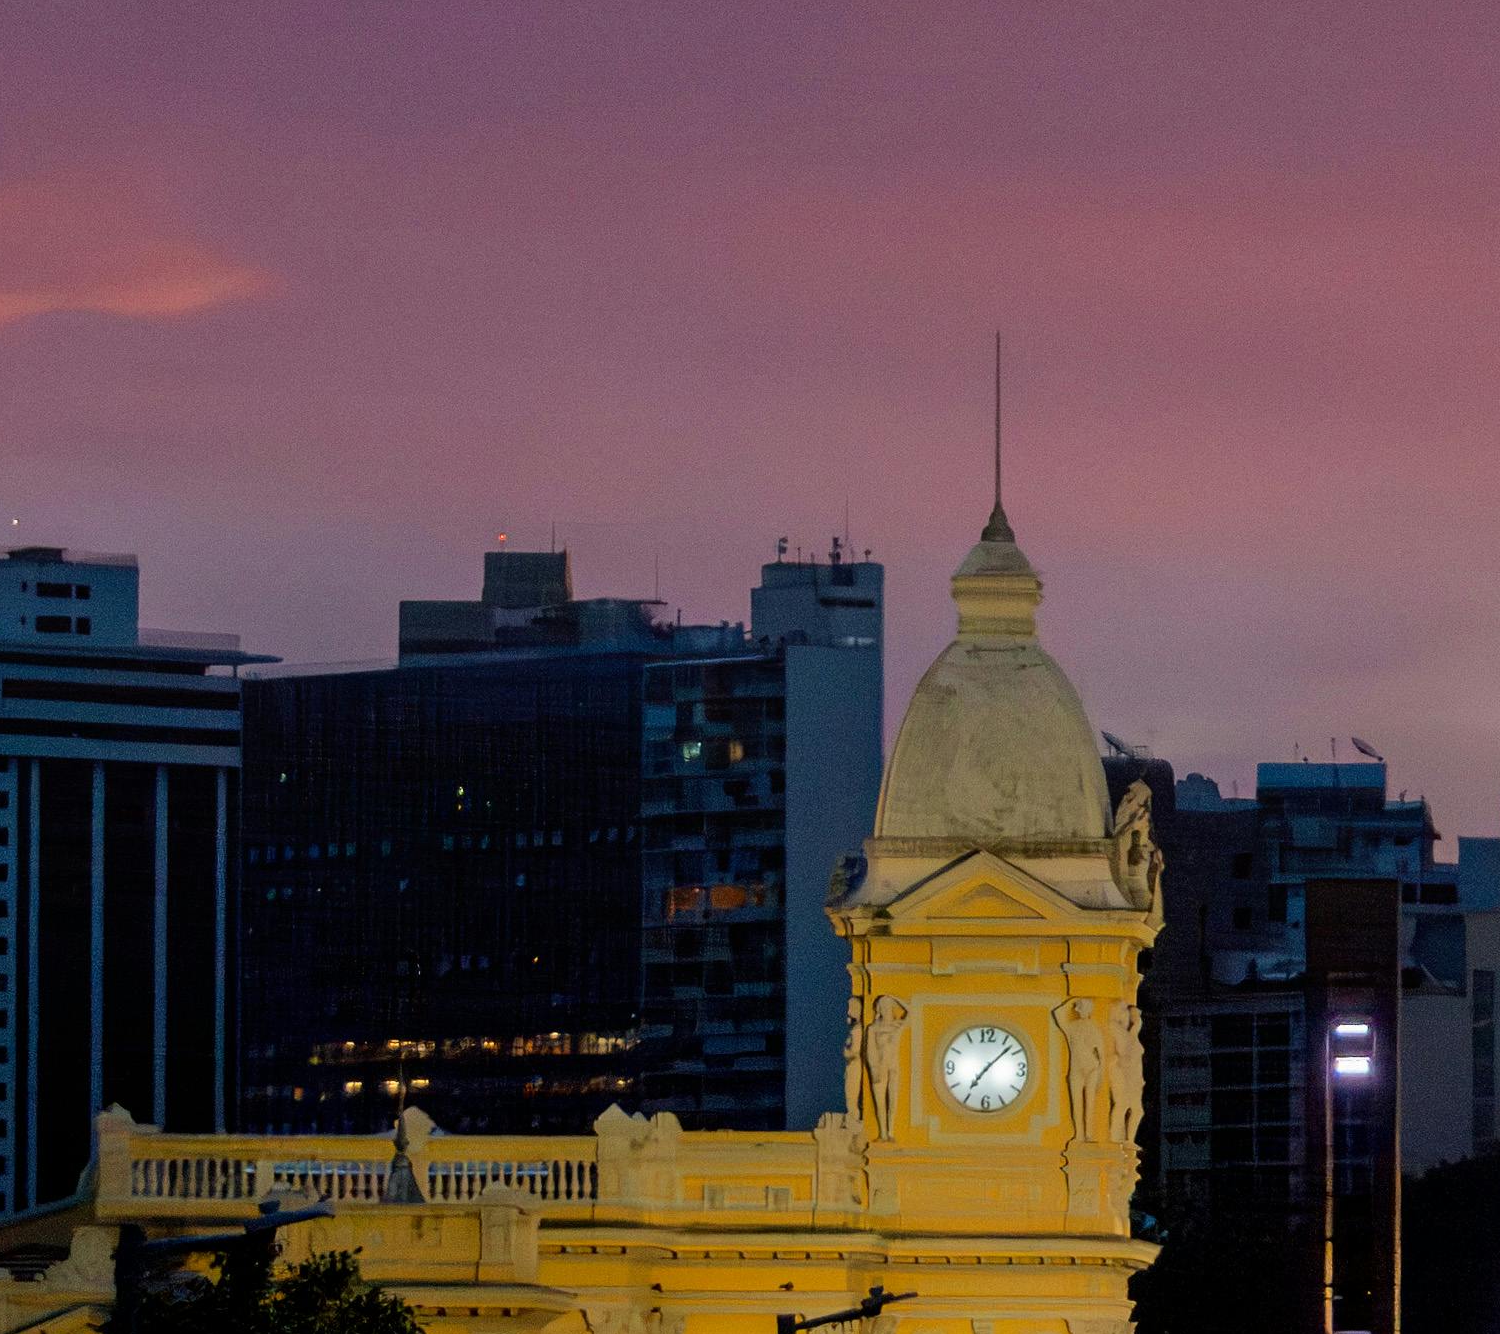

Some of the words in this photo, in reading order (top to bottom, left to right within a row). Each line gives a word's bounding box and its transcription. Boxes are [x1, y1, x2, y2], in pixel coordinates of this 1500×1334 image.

[980, 1028, 996, 1043] 12
[946, 1060, 955, 1075] 9
[1016, 1062, 1026, 1077] 3
[981, 1095, 990, 1109] 6
